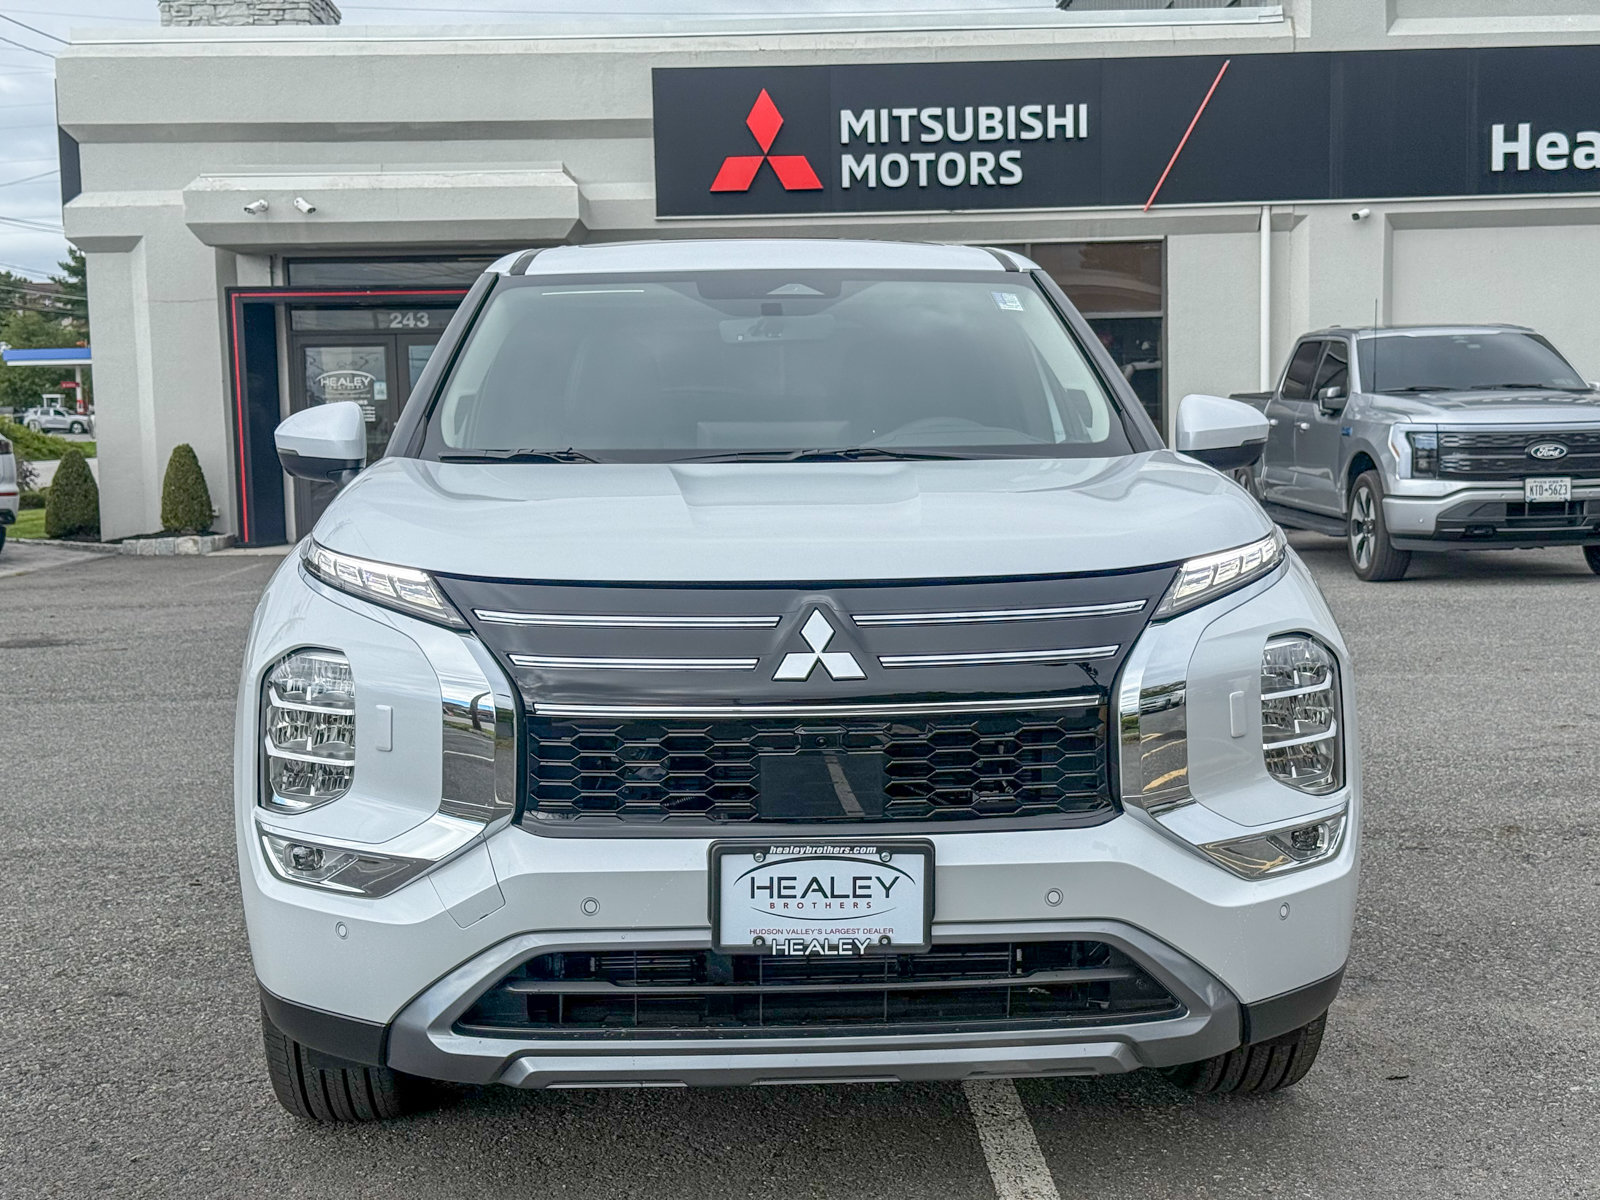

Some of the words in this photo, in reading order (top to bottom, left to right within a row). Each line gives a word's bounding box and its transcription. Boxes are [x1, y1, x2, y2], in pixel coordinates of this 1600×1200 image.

[839, 103, 1089, 144] MITSUBISHI
[1490, 122, 1600, 172] Hea
[841, 149, 1024, 189] MOTORS
[389, 311, 430, 329] 243
[320, 376, 371, 387] HEALEY
[1536, 444, 1561, 457] Ford
[769, 845, 877, 855] healeybrothers.com
[750, 875, 901, 900] HEALEY
[769, 901, 873, 910] BROTHERS
[862, 927, 895, 935] DEALER
[771, 938, 872, 956] HEALEY
